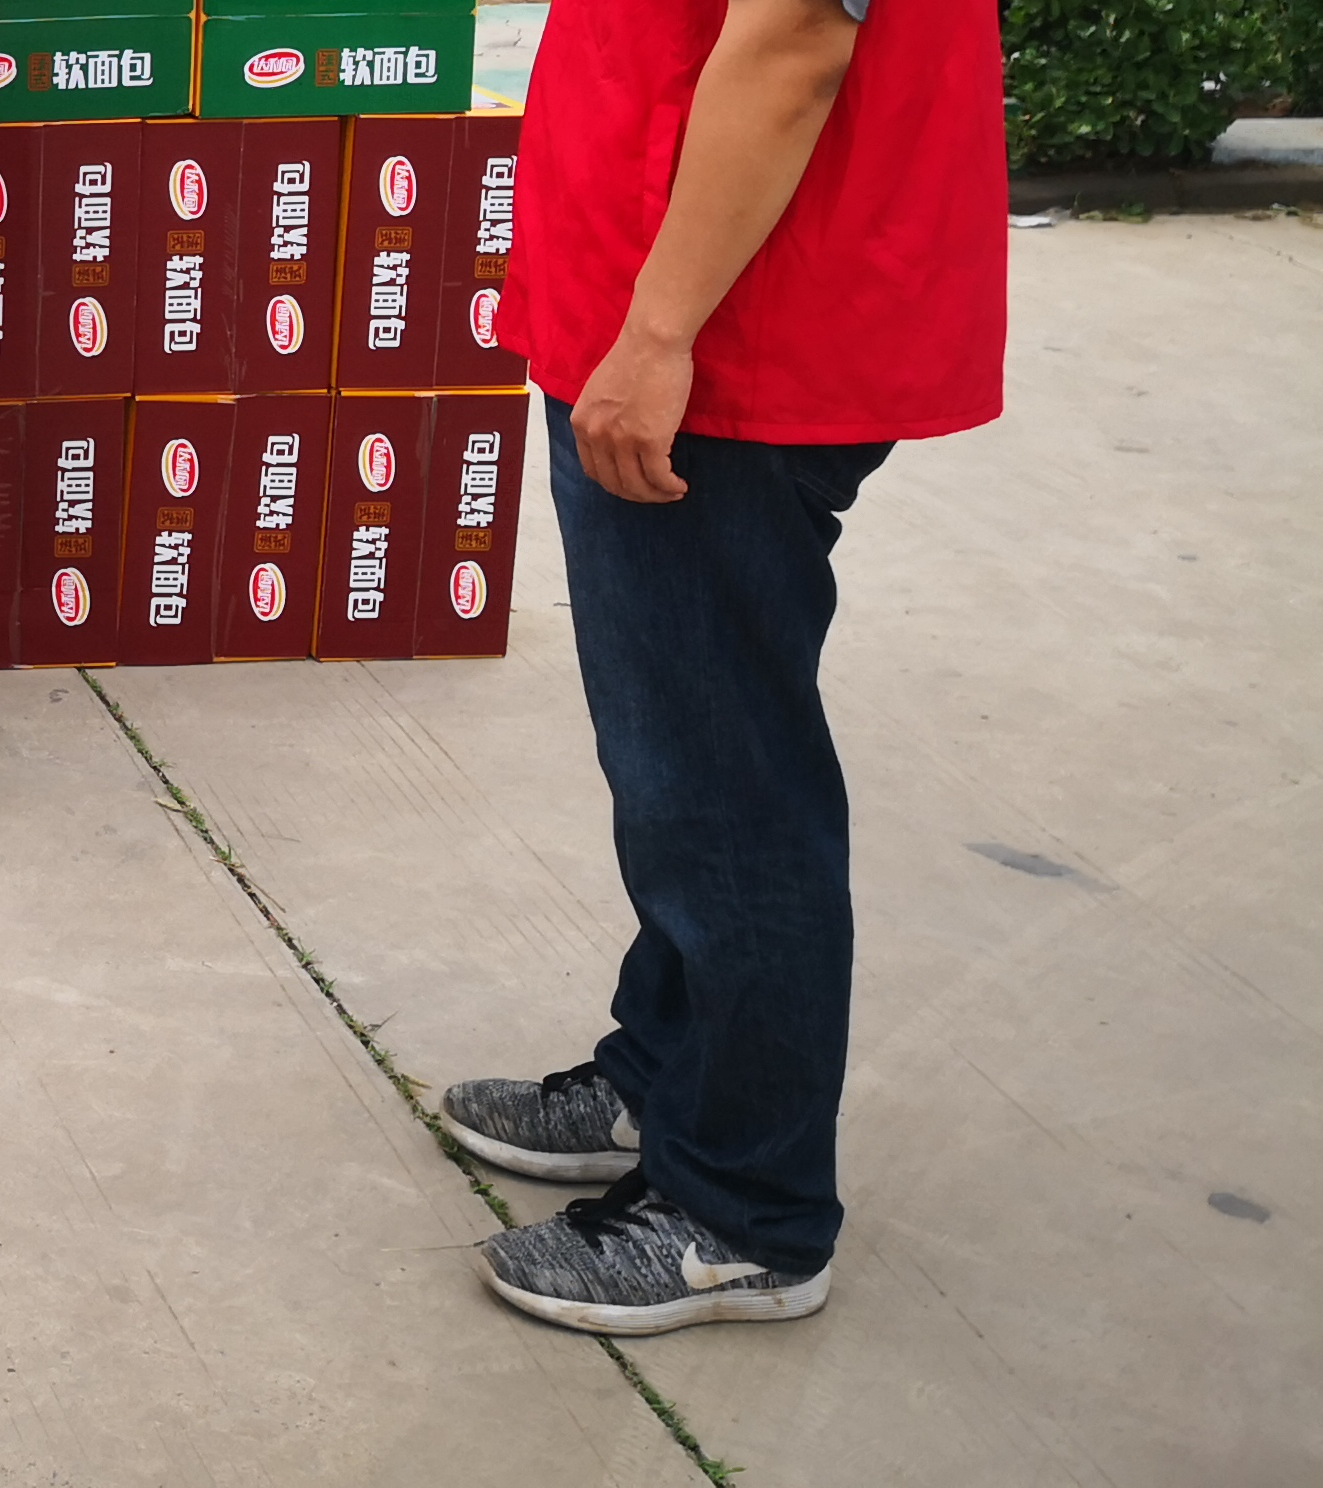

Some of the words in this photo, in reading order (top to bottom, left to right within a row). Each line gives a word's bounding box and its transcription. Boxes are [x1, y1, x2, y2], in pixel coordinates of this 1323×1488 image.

[52, 49, 154, 90] 软面包
[339, 45, 438, 86] 软面包
[72, 161, 113, 262] 软面包
[269, 160, 311, 260] 软面包
[476, 155, 518, 254] 软面包
[163, 254, 204, 354] 软面包
[368, 251, 411, 350] 软面包
[54, 437, 95, 533] 软面包
[255, 432, 300, 529] 软面包
[456, 431, 501, 527] 软面包
[149, 530, 193, 627] 软面包
[347, 525, 390, 621] 软面包
